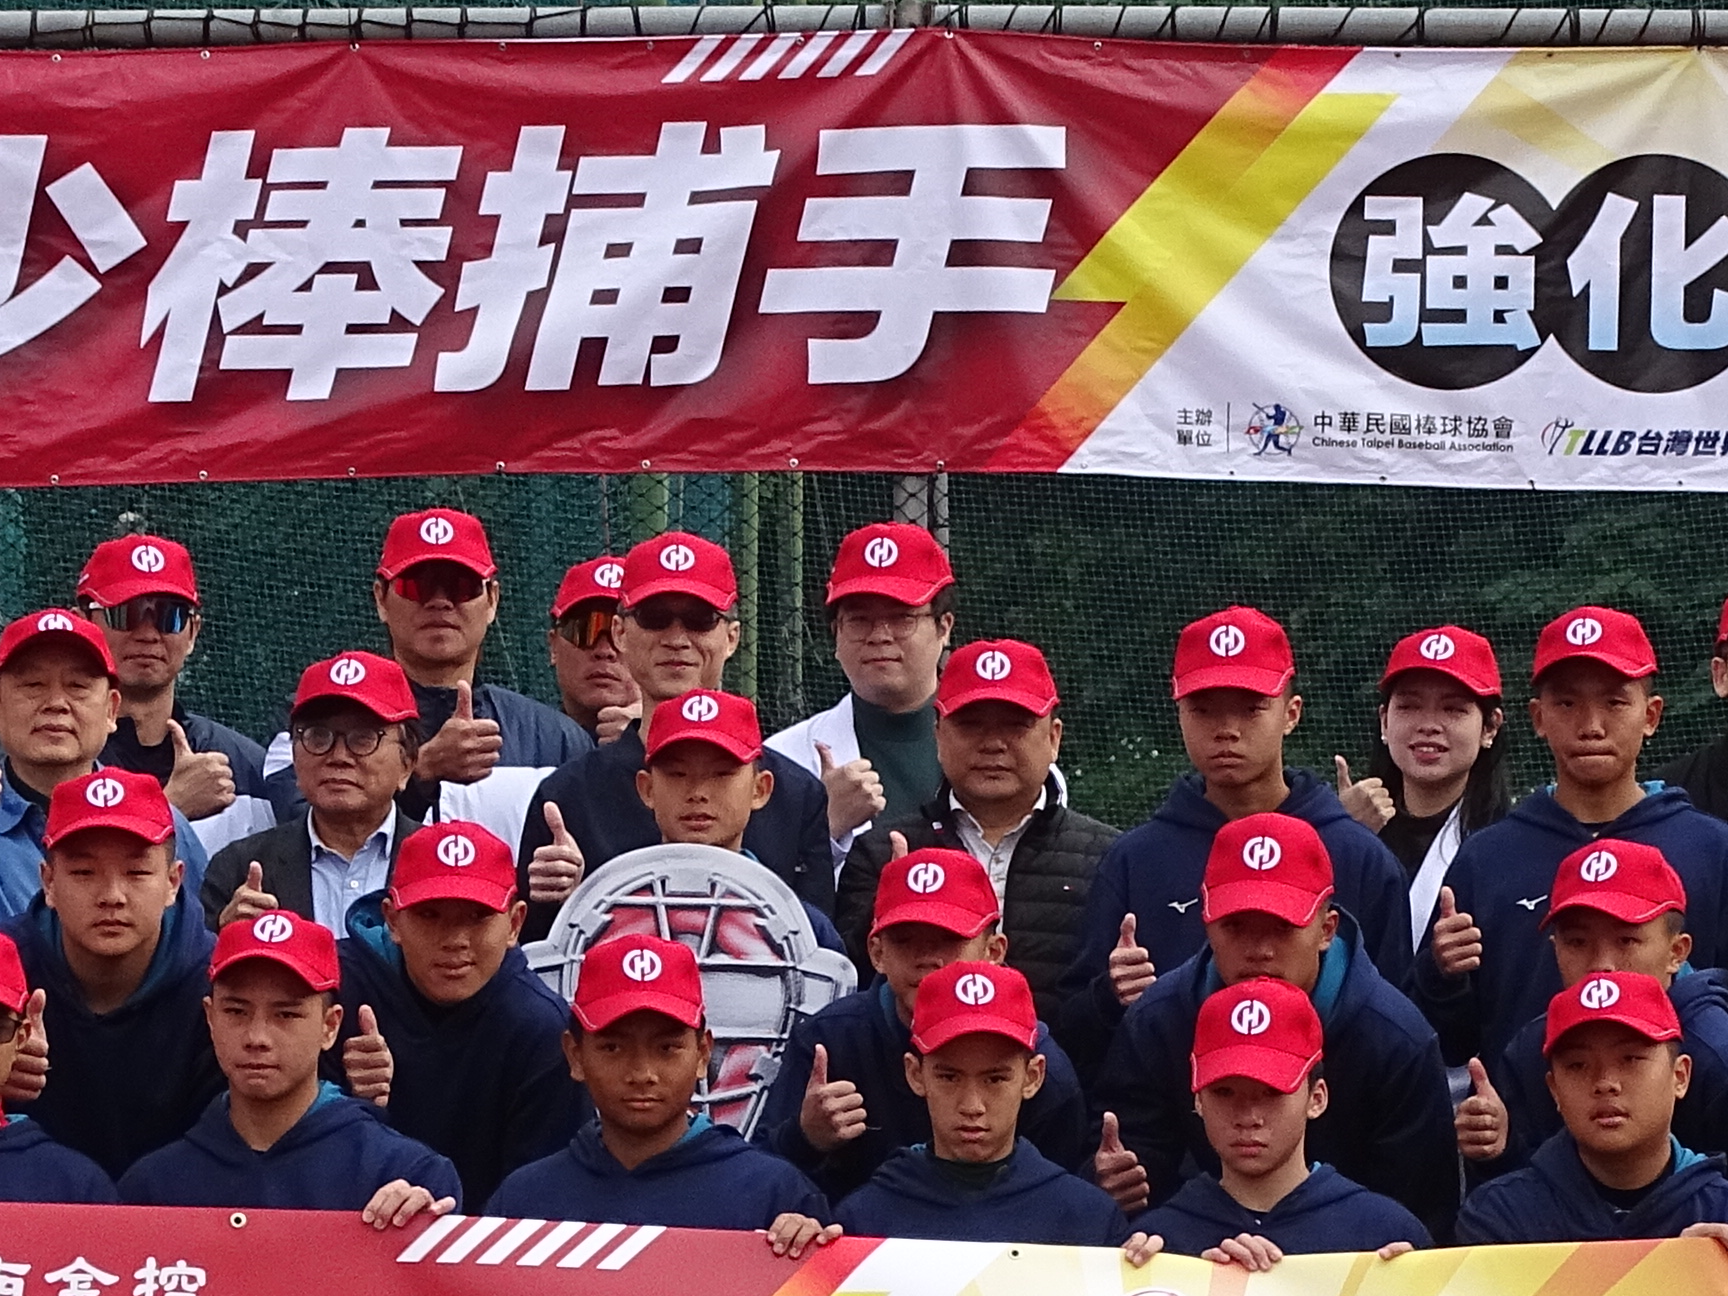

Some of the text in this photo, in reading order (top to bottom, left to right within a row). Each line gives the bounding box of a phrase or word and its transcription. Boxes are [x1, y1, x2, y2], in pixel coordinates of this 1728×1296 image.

[1176, 408, 1213, 426] 主辦
[1312, 410, 1515, 440] 中華民國棒球協會
[1176, 428, 1213, 448] 單位
[1311, 436, 1515, 454] Chinese Taipei Baseball Association
